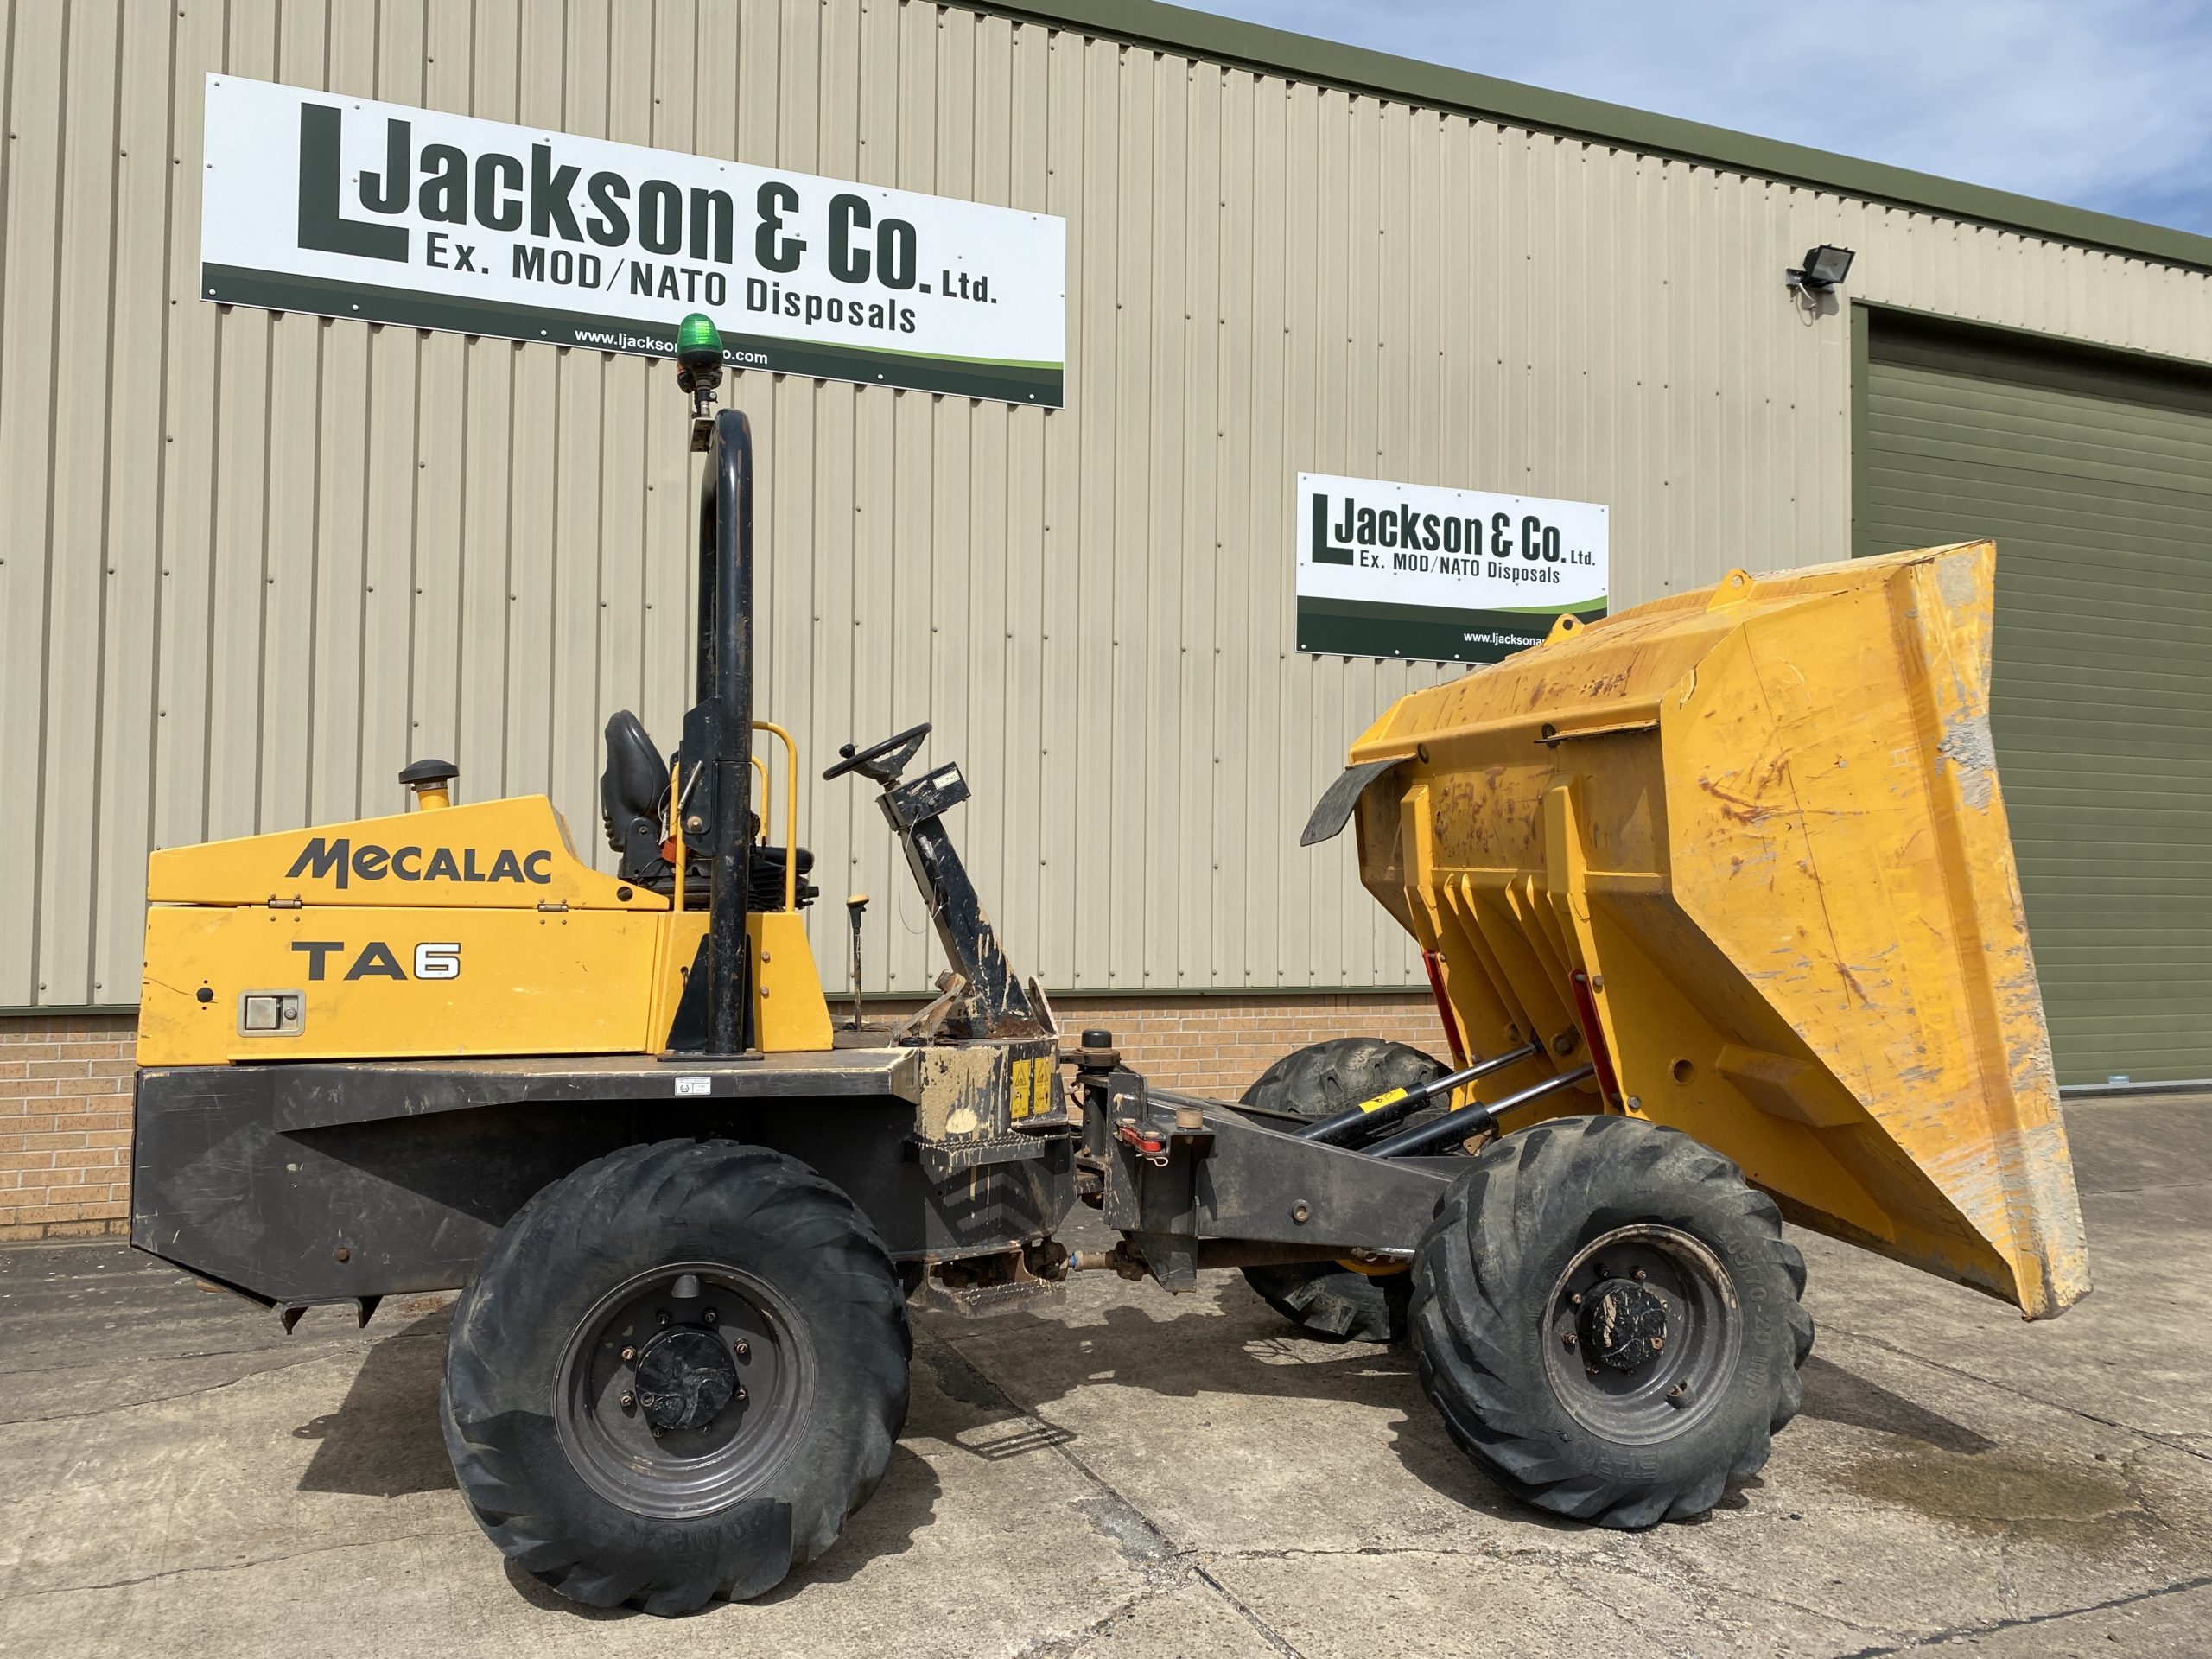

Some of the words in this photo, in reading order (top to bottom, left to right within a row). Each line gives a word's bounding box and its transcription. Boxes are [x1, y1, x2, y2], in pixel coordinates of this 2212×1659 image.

[828, 194, 931, 294] Co.
[426, 232, 490, 275] Ex.
[512, 244, 727, 306] MOD/NATO
[747, 277, 916, 334] Disposals
[942, 270, 998, 304] Ltd.
[1522, 516, 1567, 563] Co.
[1571, 550, 1596, 567] Ltd.
[1360, 550, 1385, 569] Ex.
[1393, 552, 1479, 576] MOD/NATO
[1488, 561, 1560, 584] Disposals
[291, 941, 461, 981] TA6
